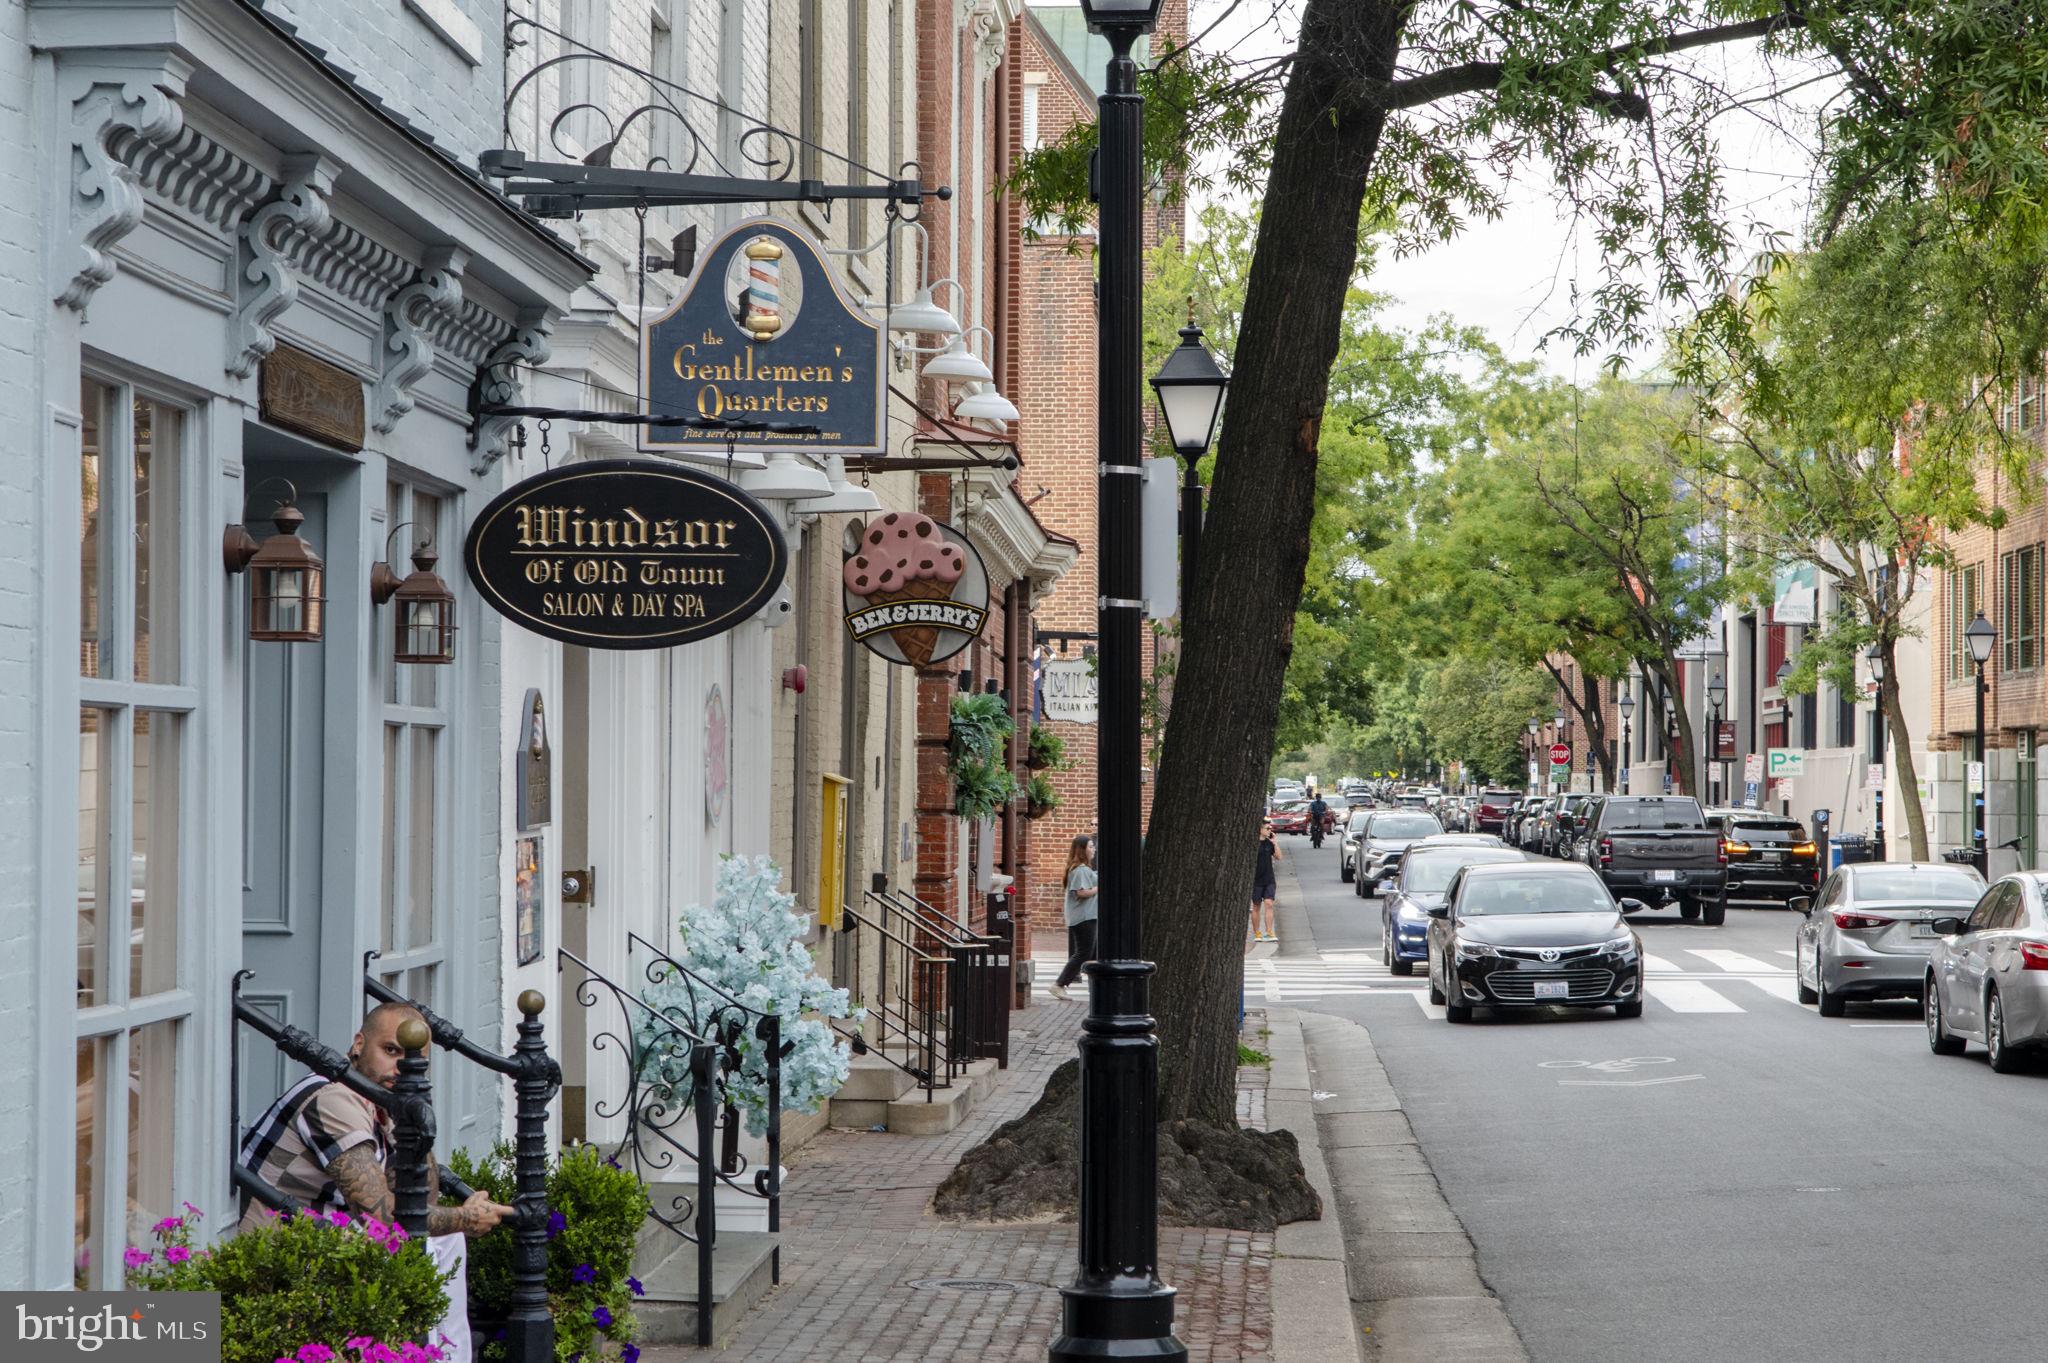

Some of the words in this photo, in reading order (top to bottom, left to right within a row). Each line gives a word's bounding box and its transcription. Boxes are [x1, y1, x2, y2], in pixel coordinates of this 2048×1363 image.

[702, 328, 724, 345] the
[673, 344, 854, 383] Gentlemen's
[697, 384, 830, 420] Quarters
[683, 428, 702, 440] fine
[744, 430, 762, 440] and
[821, 431, 842, 440] men
[514, 504, 738, 549] Windsor
[524, 558, 565, 585] Of
[573, 558, 628, 585] Old
[639, 559, 726, 586] Town
[542, 592, 605, 616] SALON
[611, 593, 624, 617] &
[632, 593, 668, 617] DAY
[673, 594, 707, 618] SPA
[851, 604, 981, 634] BEN&JERRY'S
[1049, 702, 1081, 712] ITALIAN
[1550, 750, 1569, 759] STOP
